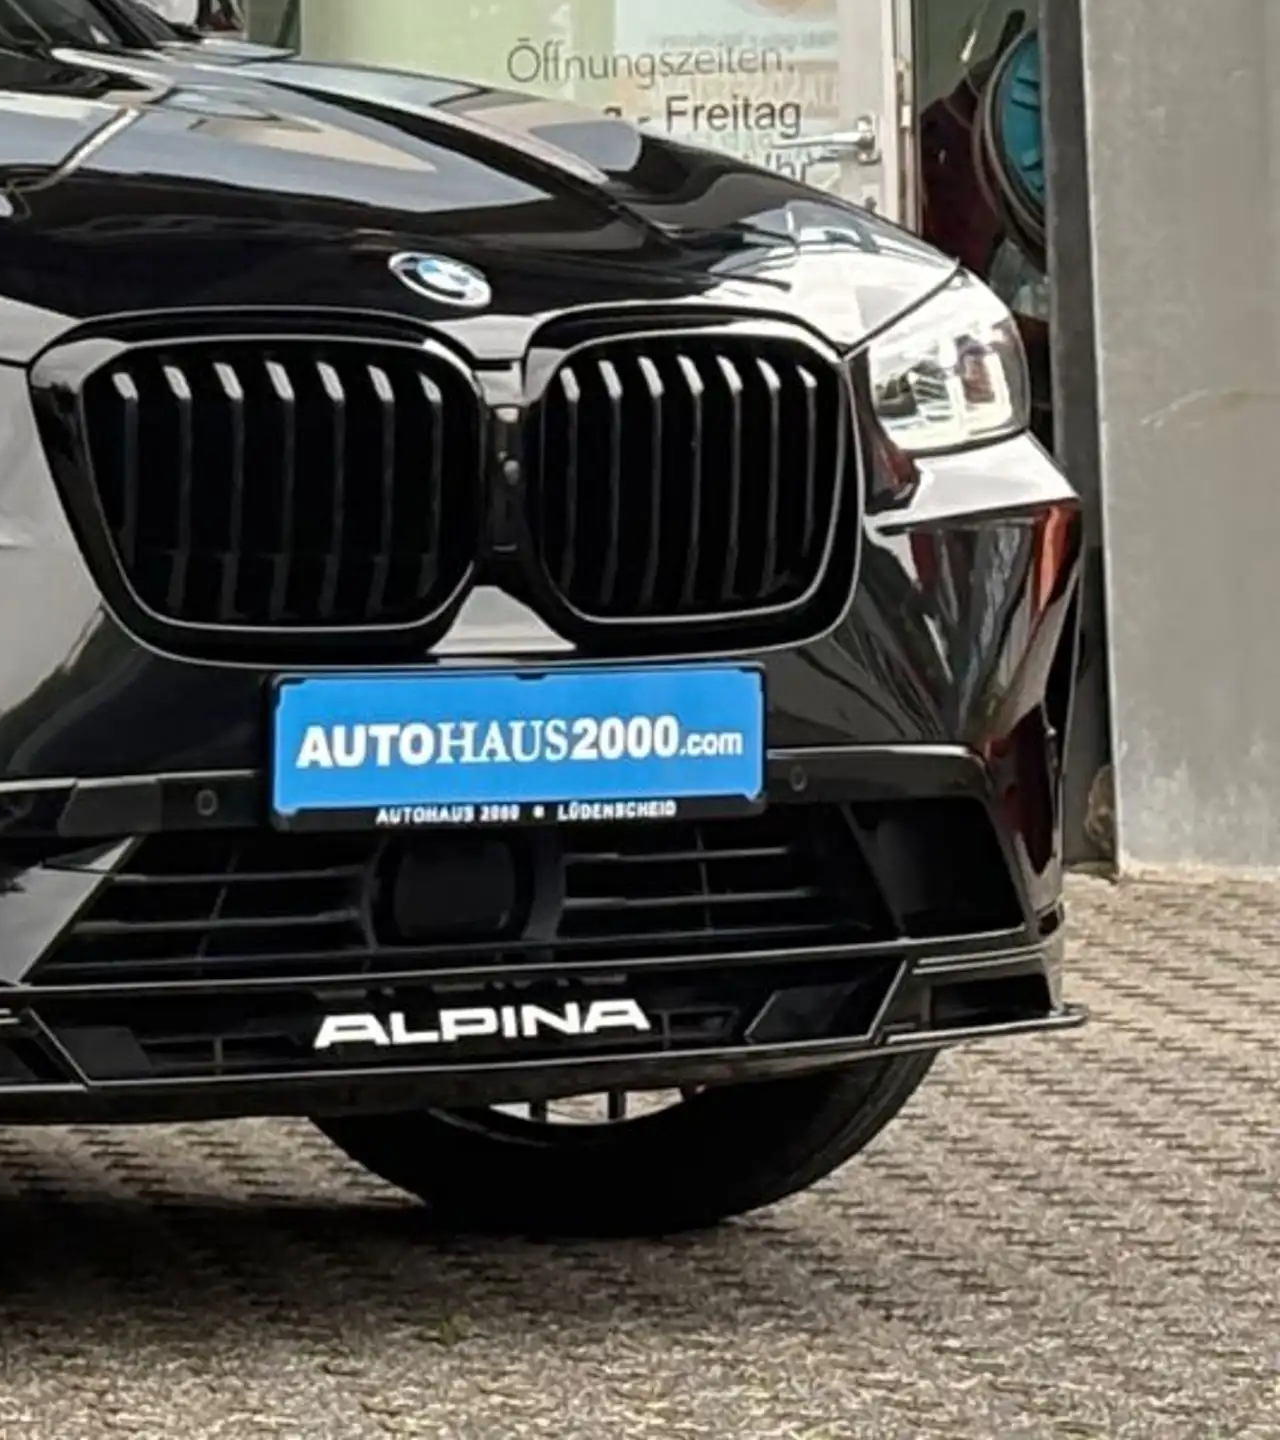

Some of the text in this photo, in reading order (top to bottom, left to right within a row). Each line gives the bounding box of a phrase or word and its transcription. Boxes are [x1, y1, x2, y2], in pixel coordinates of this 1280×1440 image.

[665, 93, 801, 139] Freitag
[295, 714, 743, 768] AUTOHAUS2000.com
[376, 806, 474, 824] AUTOHAUS
[557, 799, 676, 821] LÜDENSCHEID
[313, 998, 652, 1049] ALPINA
